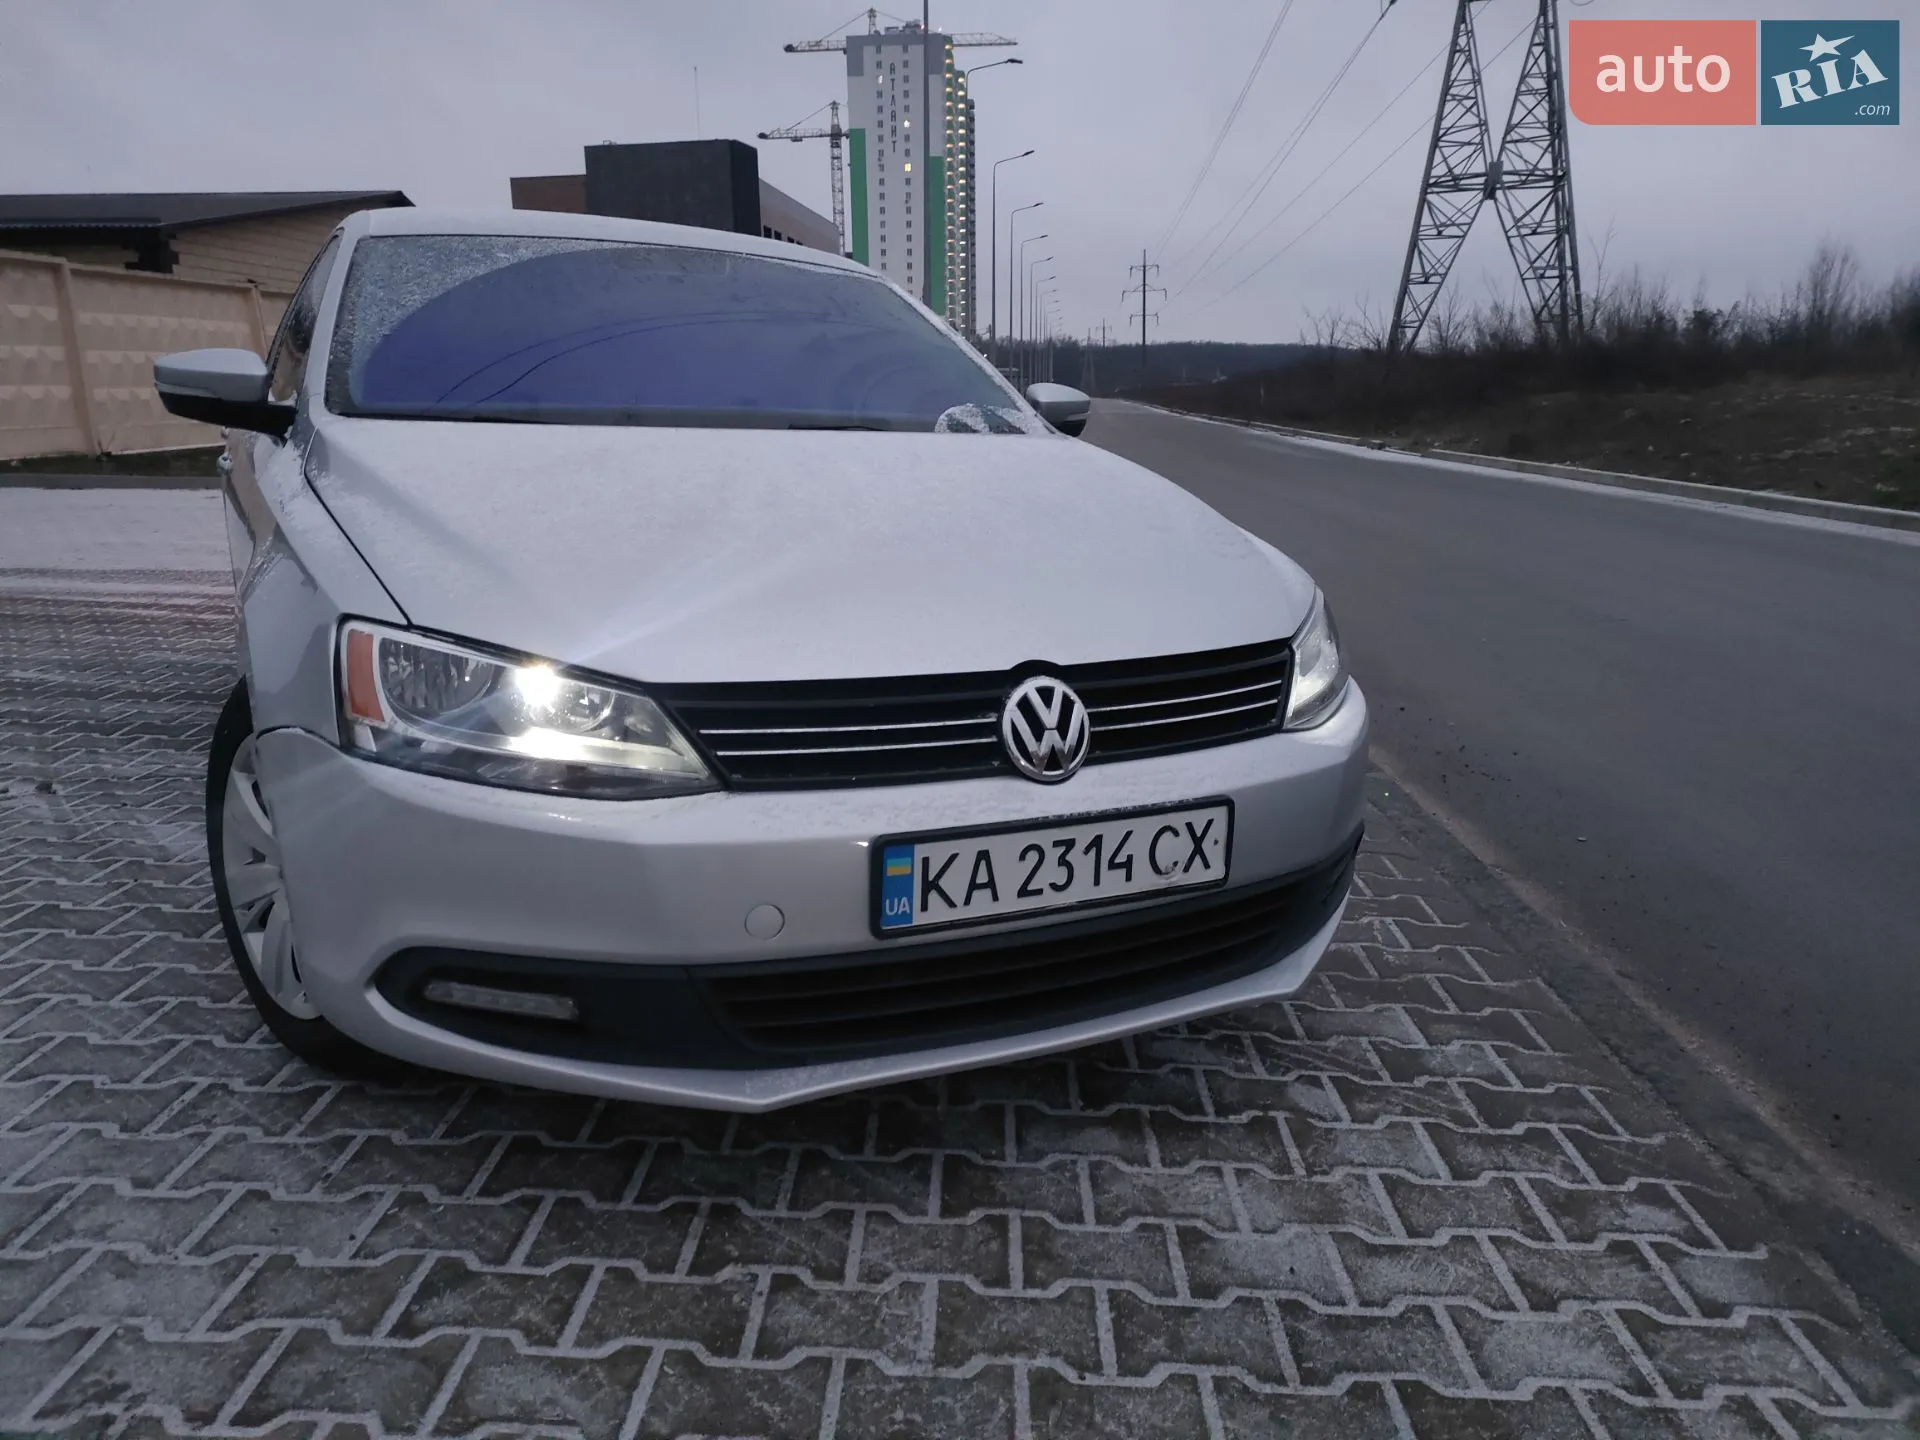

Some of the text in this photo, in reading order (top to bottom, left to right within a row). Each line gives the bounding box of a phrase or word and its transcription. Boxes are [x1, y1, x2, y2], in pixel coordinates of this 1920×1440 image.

[889, 62, 897, 153] АТЛАНТ
[885, 898, 910, 916] UA
[920, 818, 1216, 913] KA 2314 CX
